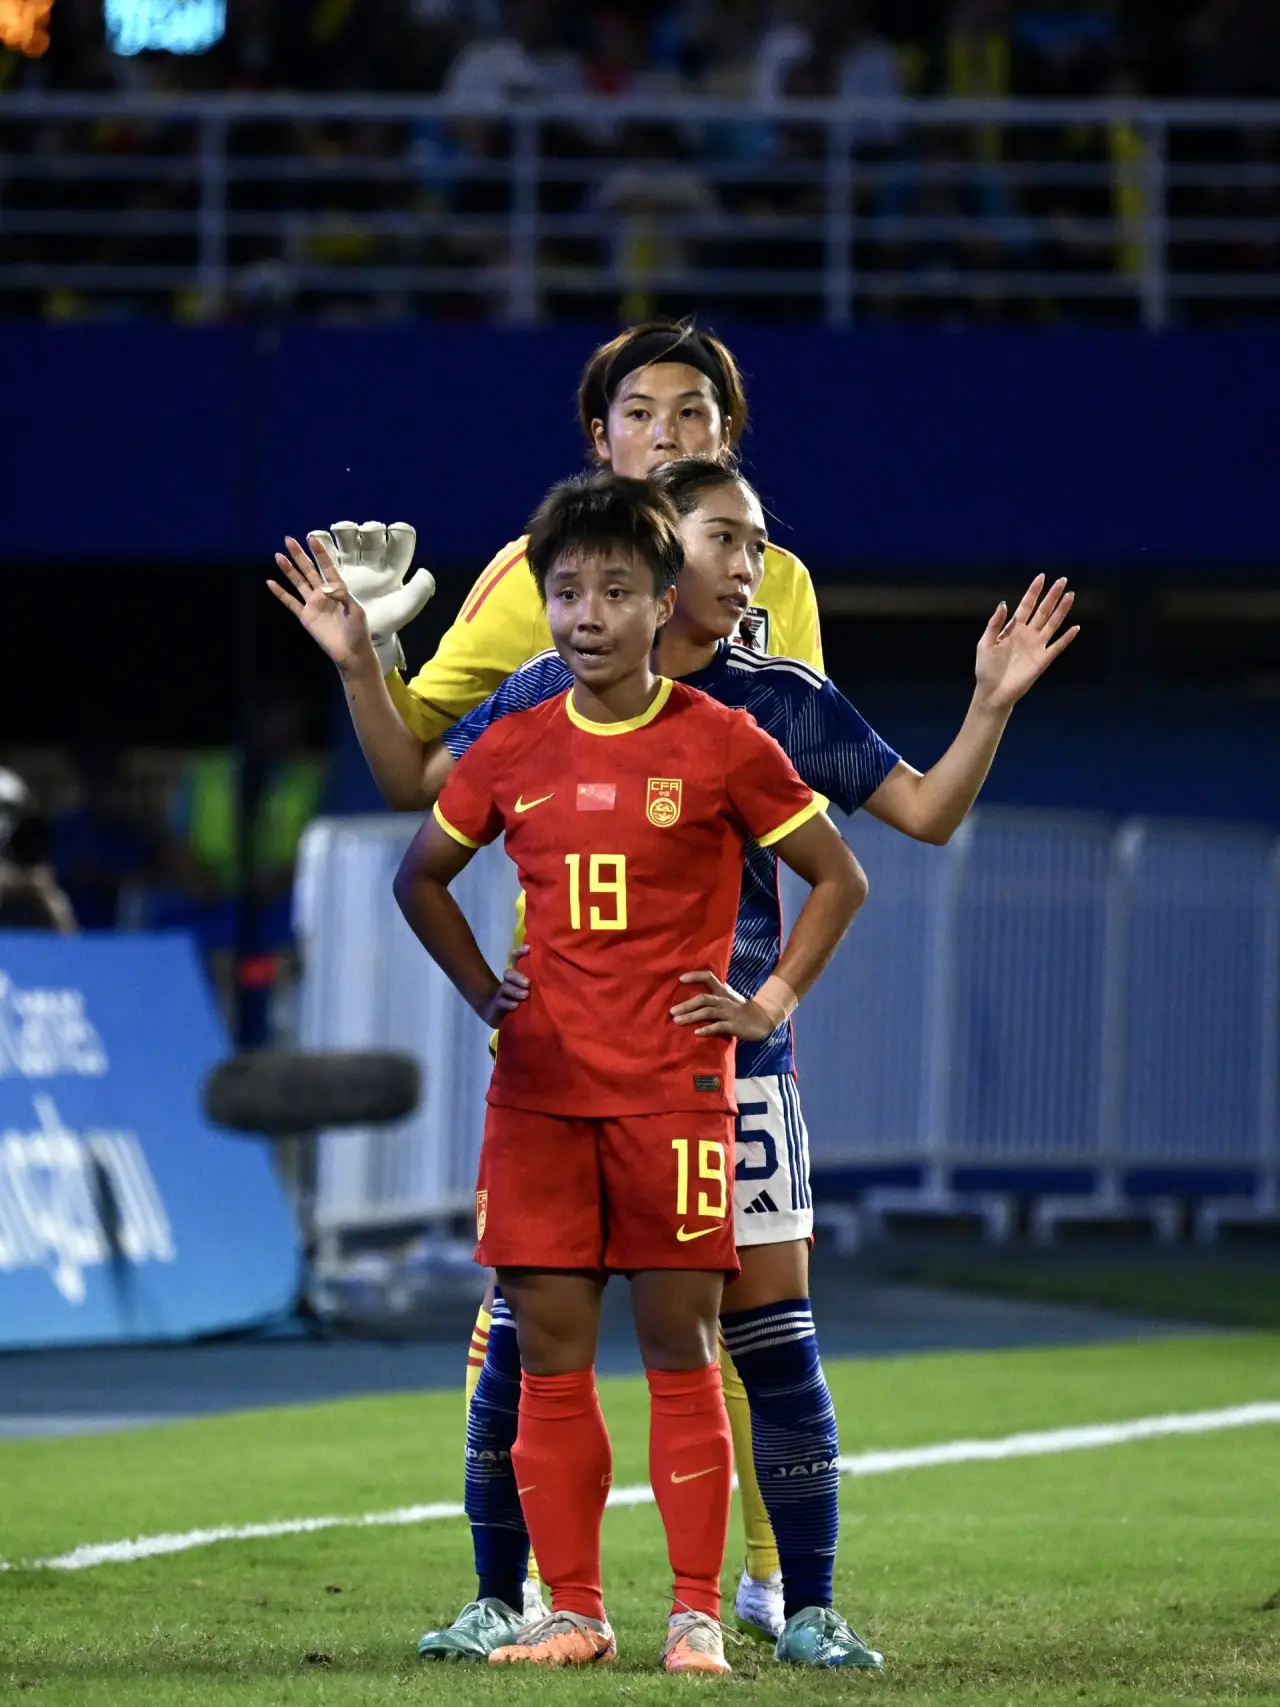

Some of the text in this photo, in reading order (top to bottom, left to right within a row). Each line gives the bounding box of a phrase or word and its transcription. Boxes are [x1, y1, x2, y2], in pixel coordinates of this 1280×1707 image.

[651, 781, 679, 791] CFA
[565, 853, 628, 930] 19
[671, 1138, 727, 1219] 19
[734, 1101, 779, 1181] 5
